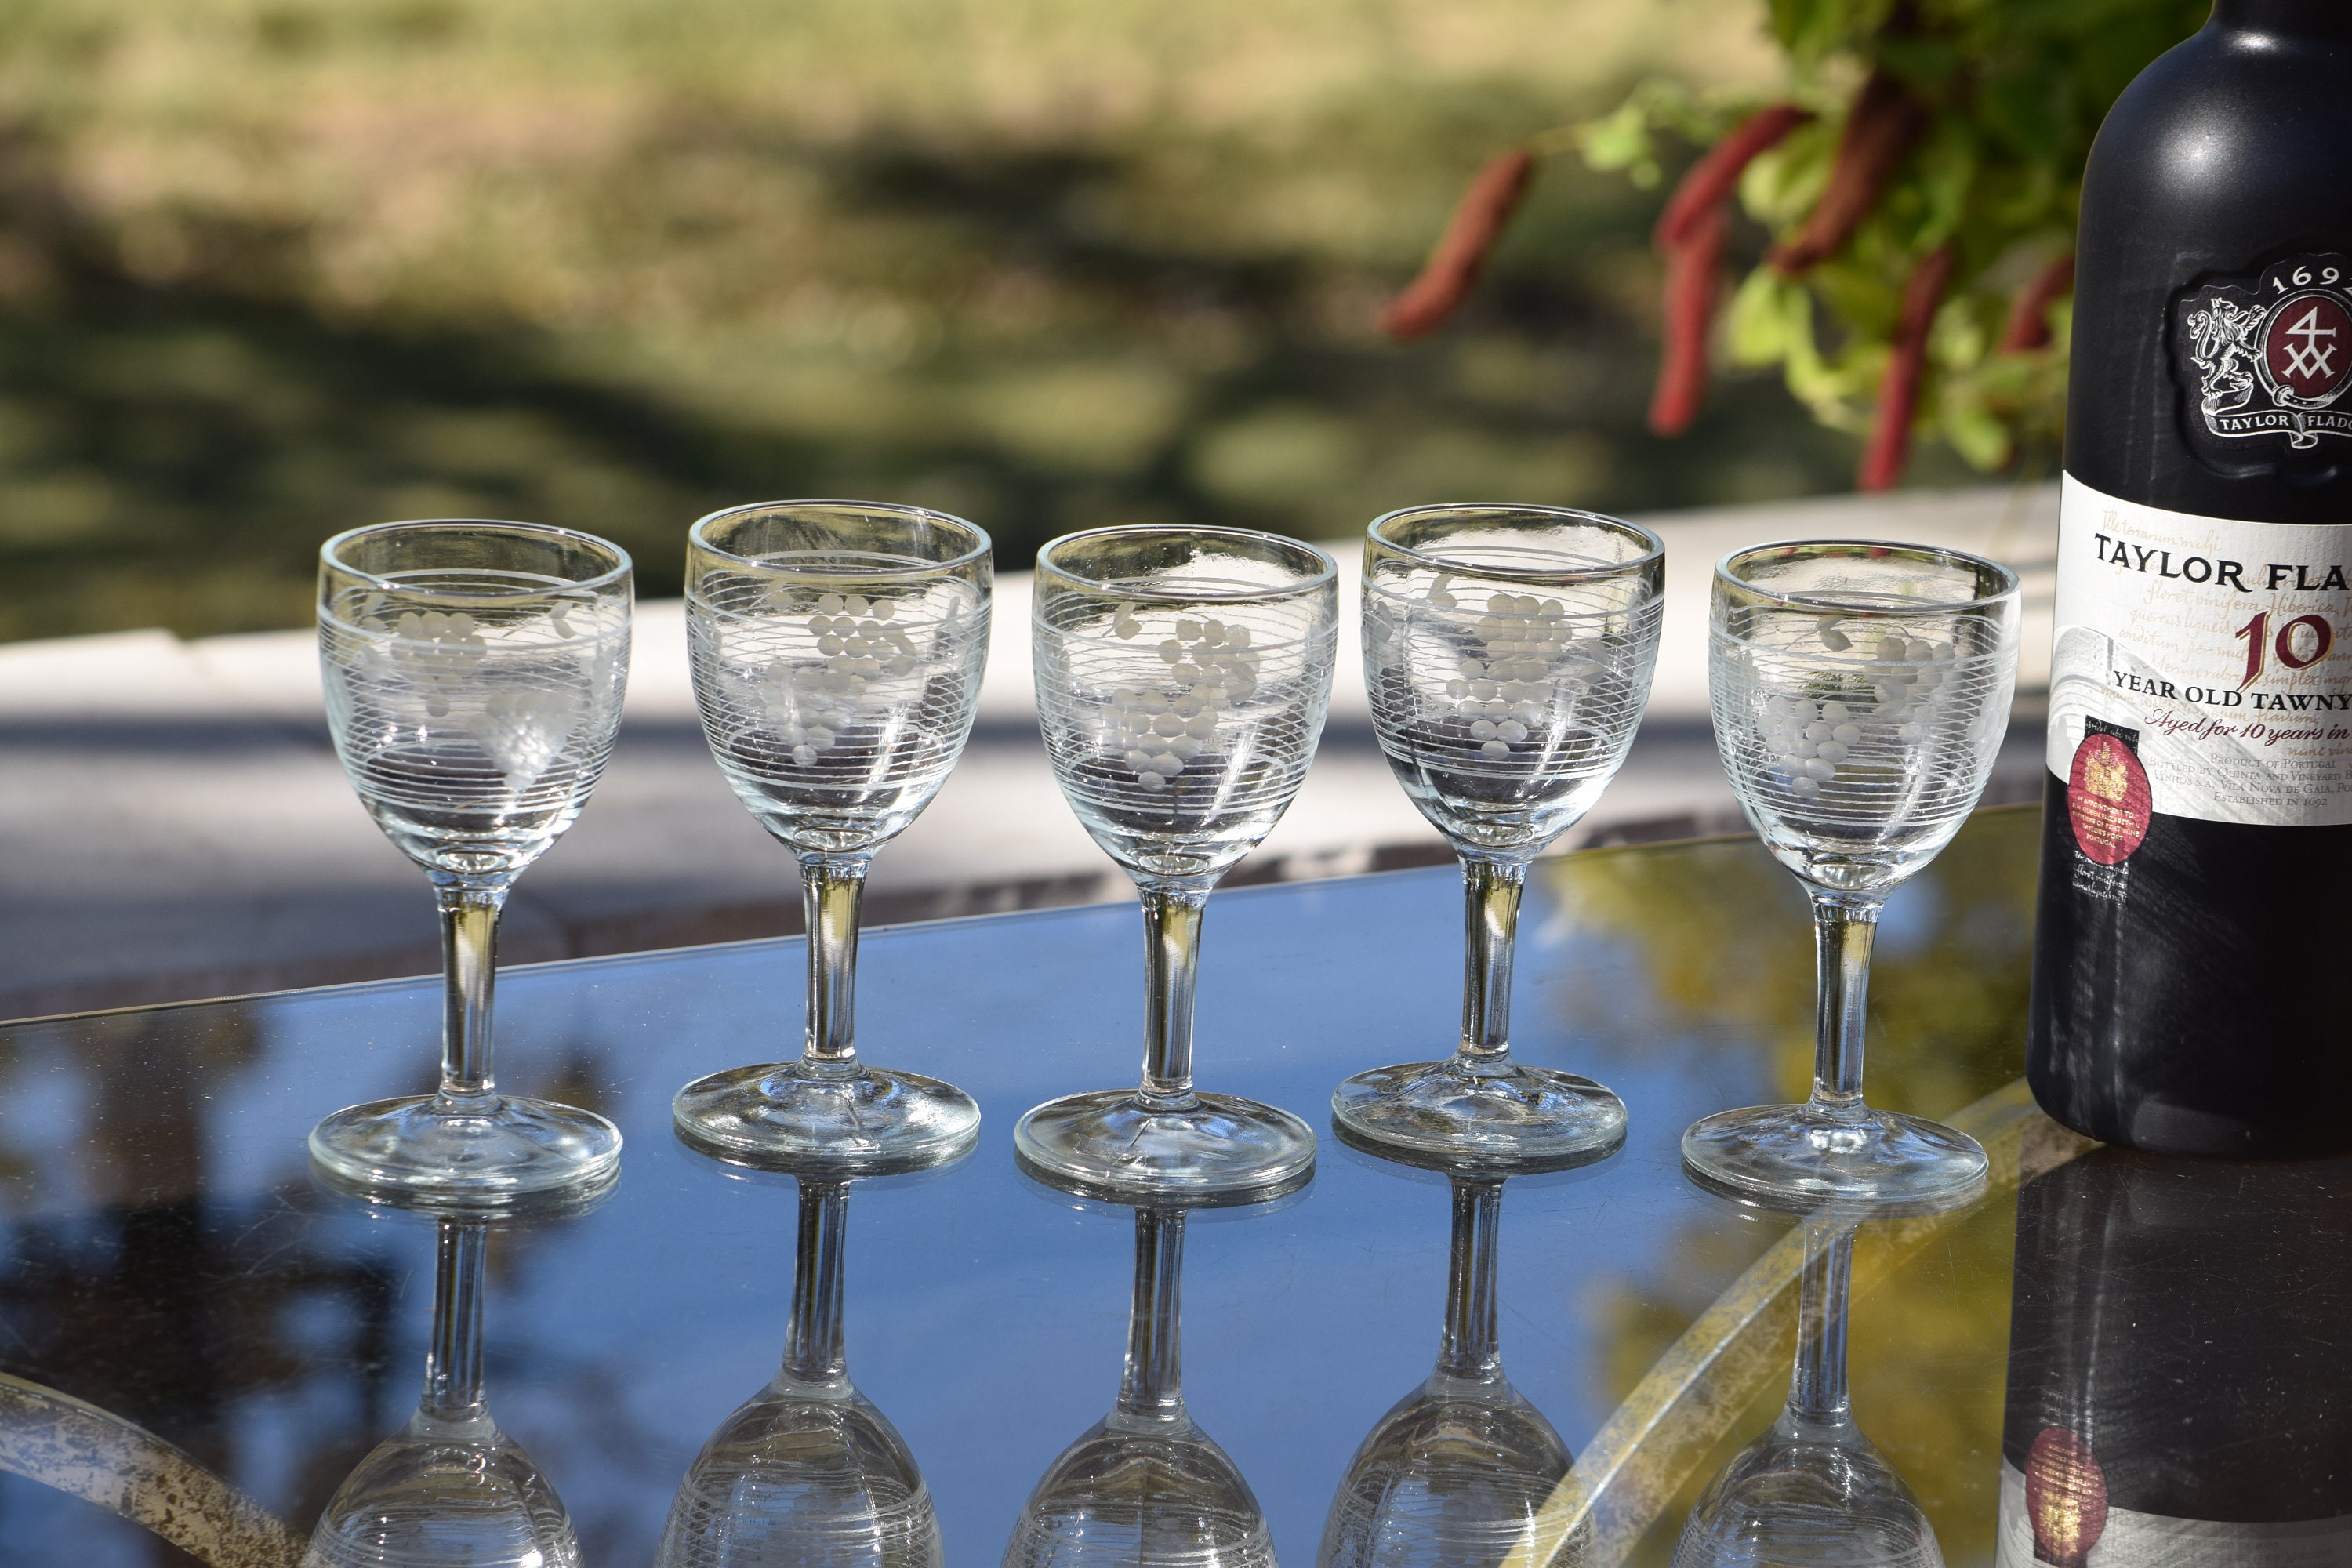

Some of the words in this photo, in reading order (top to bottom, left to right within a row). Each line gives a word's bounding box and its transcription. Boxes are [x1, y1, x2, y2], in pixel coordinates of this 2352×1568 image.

[2220, 415, 2289, 430] TAYLOR
[2094, 533, 2252, 593] TAYLOR
[2265, 564, 2350, 591] FLA
[2235, 610, 2335, 693] 10
[2113, 670, 2179, 699] YEAR
[2185, 686, 2243, 707] OLD
[2251, 692, 2352, 711] TAWNY
[2144, 708, 2202, 736] Aged
[2198, 720, 2238, 741] for
[2239, 723, 2266, 739] 10
[2264, 727, 2323, 746] years
[2326, 724, 2350, 739] in
[2148, 756, 2196, 774] BOTTLED
[2199, 767, 2212, 776] BY
[2216, 766, 2262, 781] QUINTA
[2265, 772, 2288, 781] AND
[2290, 771, 2342, 782] VINEYARD
[2210, 753, 2262, 768] PRODUCT
[2266, 760, 2280, 768] OF
[2283, 758, 2337, 768] PORTUGAL
[2153, 769, 2193, 786] VINHOS
[2220, 779, 2245, 792] VILA
[2249, 782, 2281, 793] NOVA
[2285, 785, 2300, 794] DE
[2303, 783, 2334, 795] GAIA,
[2083, 798, 2123, 815] APPOINTMENT
[2124, 810, 2134, 819] TO
[2212, 791, 2283, 806] ESTABLISHED
[2303, 795, 2328, 808] 1692
[2101, 813, 2134, 826] ELIZABETH
[2085, 833, 2117, 848] PORTUGAL
[2107, 832, 2124, 841] PORT
[2122, 827, 2140, 837] WINE
